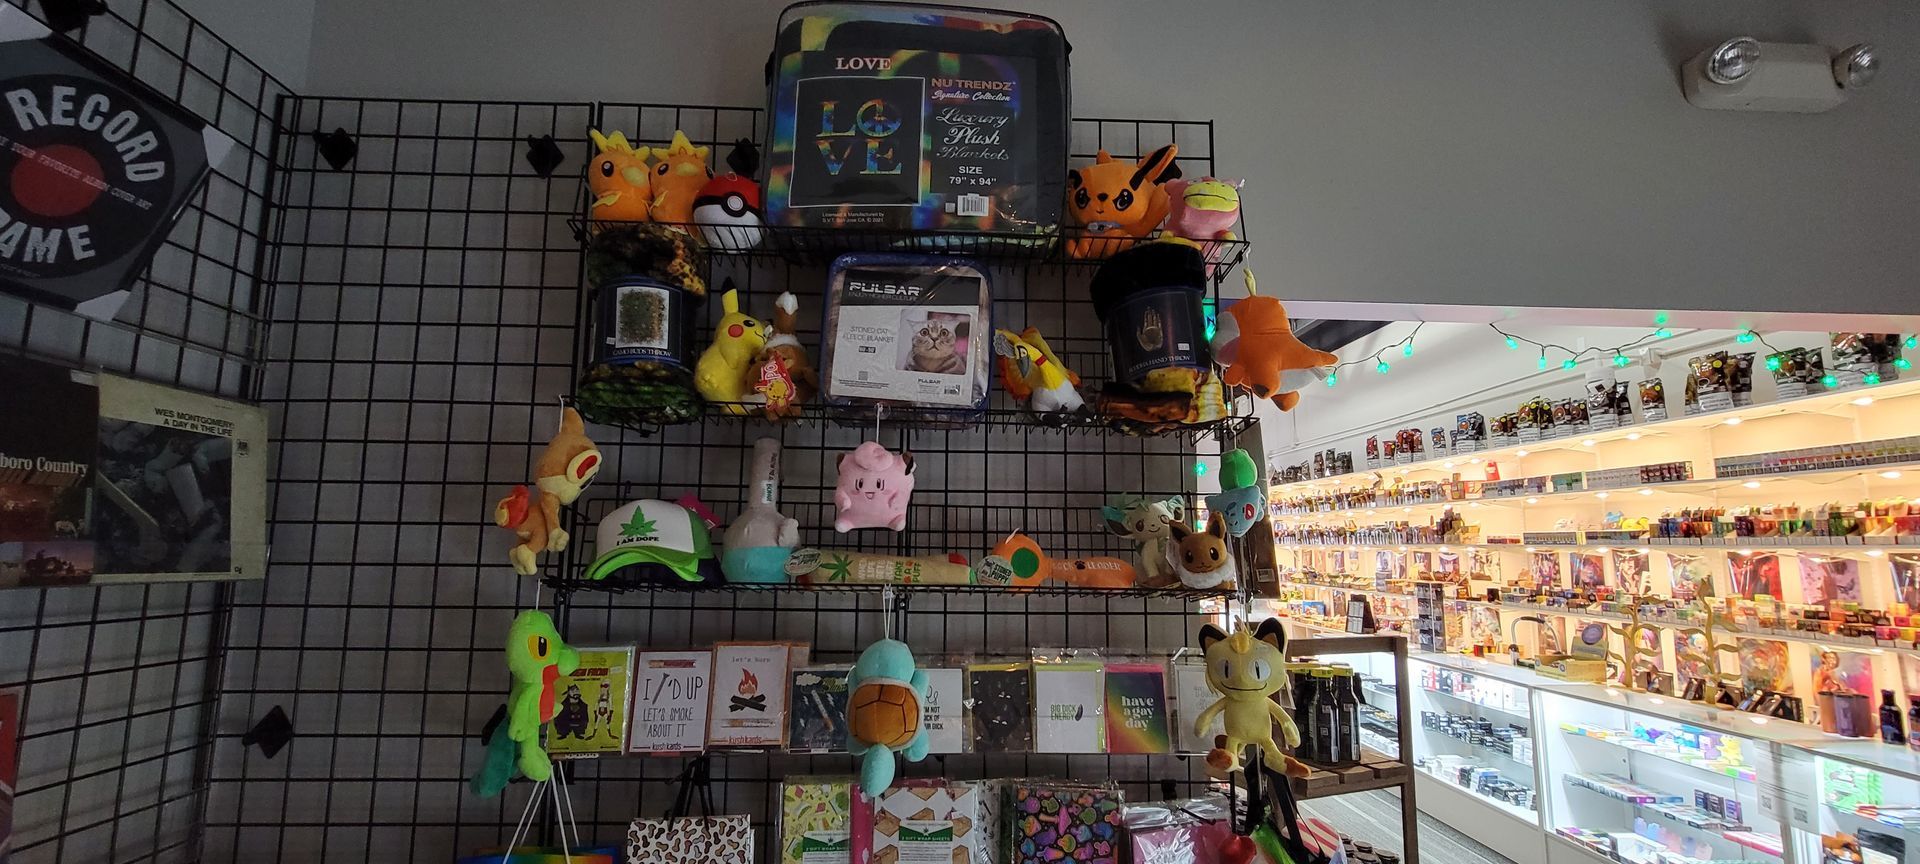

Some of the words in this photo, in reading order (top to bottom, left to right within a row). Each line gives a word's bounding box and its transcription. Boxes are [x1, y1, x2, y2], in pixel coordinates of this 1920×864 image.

[835, 56, 891, 70] LOVE
[931, 78, 952, 88] NU
[955, 79, 1013, 91] TRENDZ
[931, 89, 970, 101] Signature
[972, 91, 1011, 102] Collection
[936, 106, 1008, 128] Luxury
[5, 85, 165, 182] RECORD
[944, 124, 1000, 145] Plush
[936, 146, 1009, 161] Blankets
[38, 154, 82, 180] FAVORITE
[82, 174, 110, 192] ALBUM
[958, 166, 984, 174] SIZE
[949, 176, 967, 185] 79"
[979, 177, 997, 186] 94"
[849, 282, 920, 296] PULSAR
[647, 349, 672, 357] THROW
[154, 407, 175, 418] WES
[164, 418, 170, 426] A
[172, 419, 188, 429] DAY
[190, 422, 199, 431] IN
[200, 424, 215, 434] THE
[217, 426, 232, 437] LIFE
[36, 456, 89, 478] Country
[894, 560, 904, 581] TAKE
[912, 562, 922, 584] PUFF
[991, 570, 1008, 583] PUPPY
[643, 678, 652, 700] I
[687, 676, 703, 700] UP
[1051, 704, 1060, 712] BIG
[1062, 704, 1076, 712] DICK
[1121, 696, 1154, 707] have
[643, 708, 666, 722] LET'S
[670, 707, 694, 721] SMOKE
[647, 724, 672, 738] ABOUT
[676, 724, 686, 737] IT
[1125, 718, 1148, 731] day
